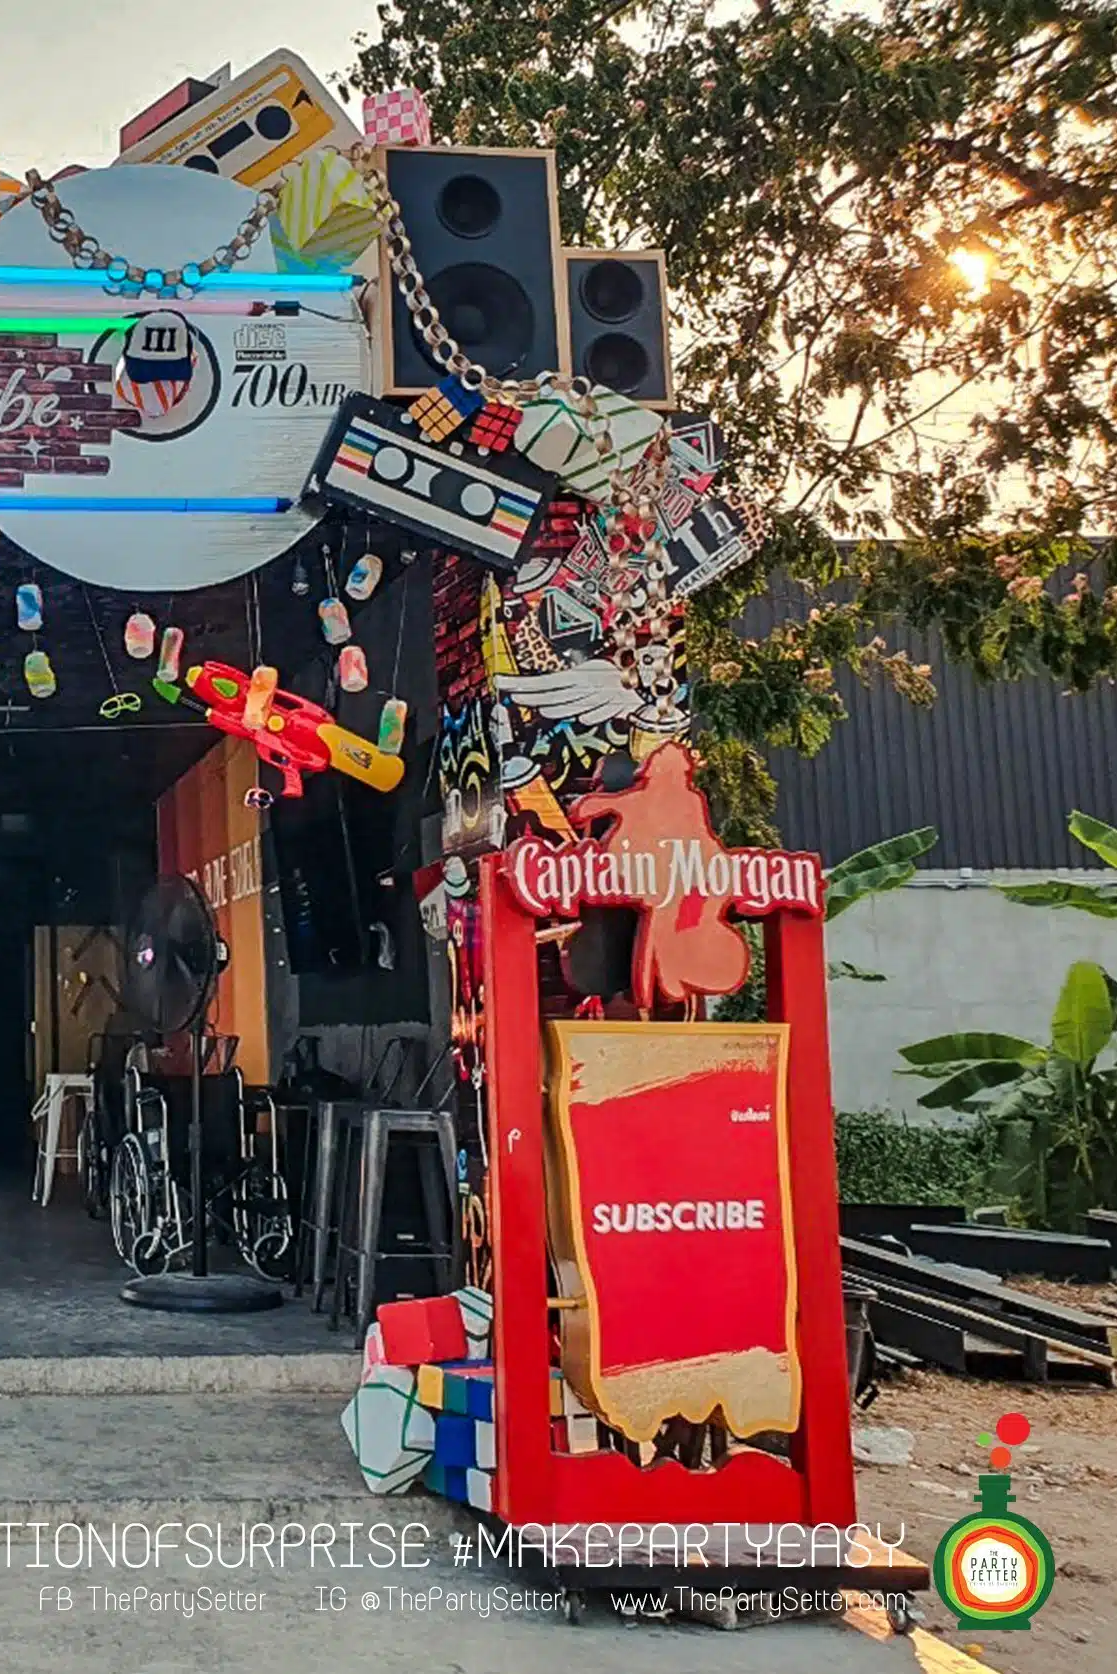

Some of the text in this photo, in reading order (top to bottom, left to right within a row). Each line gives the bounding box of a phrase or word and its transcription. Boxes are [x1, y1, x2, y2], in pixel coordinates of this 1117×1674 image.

[514, 837, 820, 911] Captain Morgan
[592, 1199, 765, 1235] SUBSCRIBE
